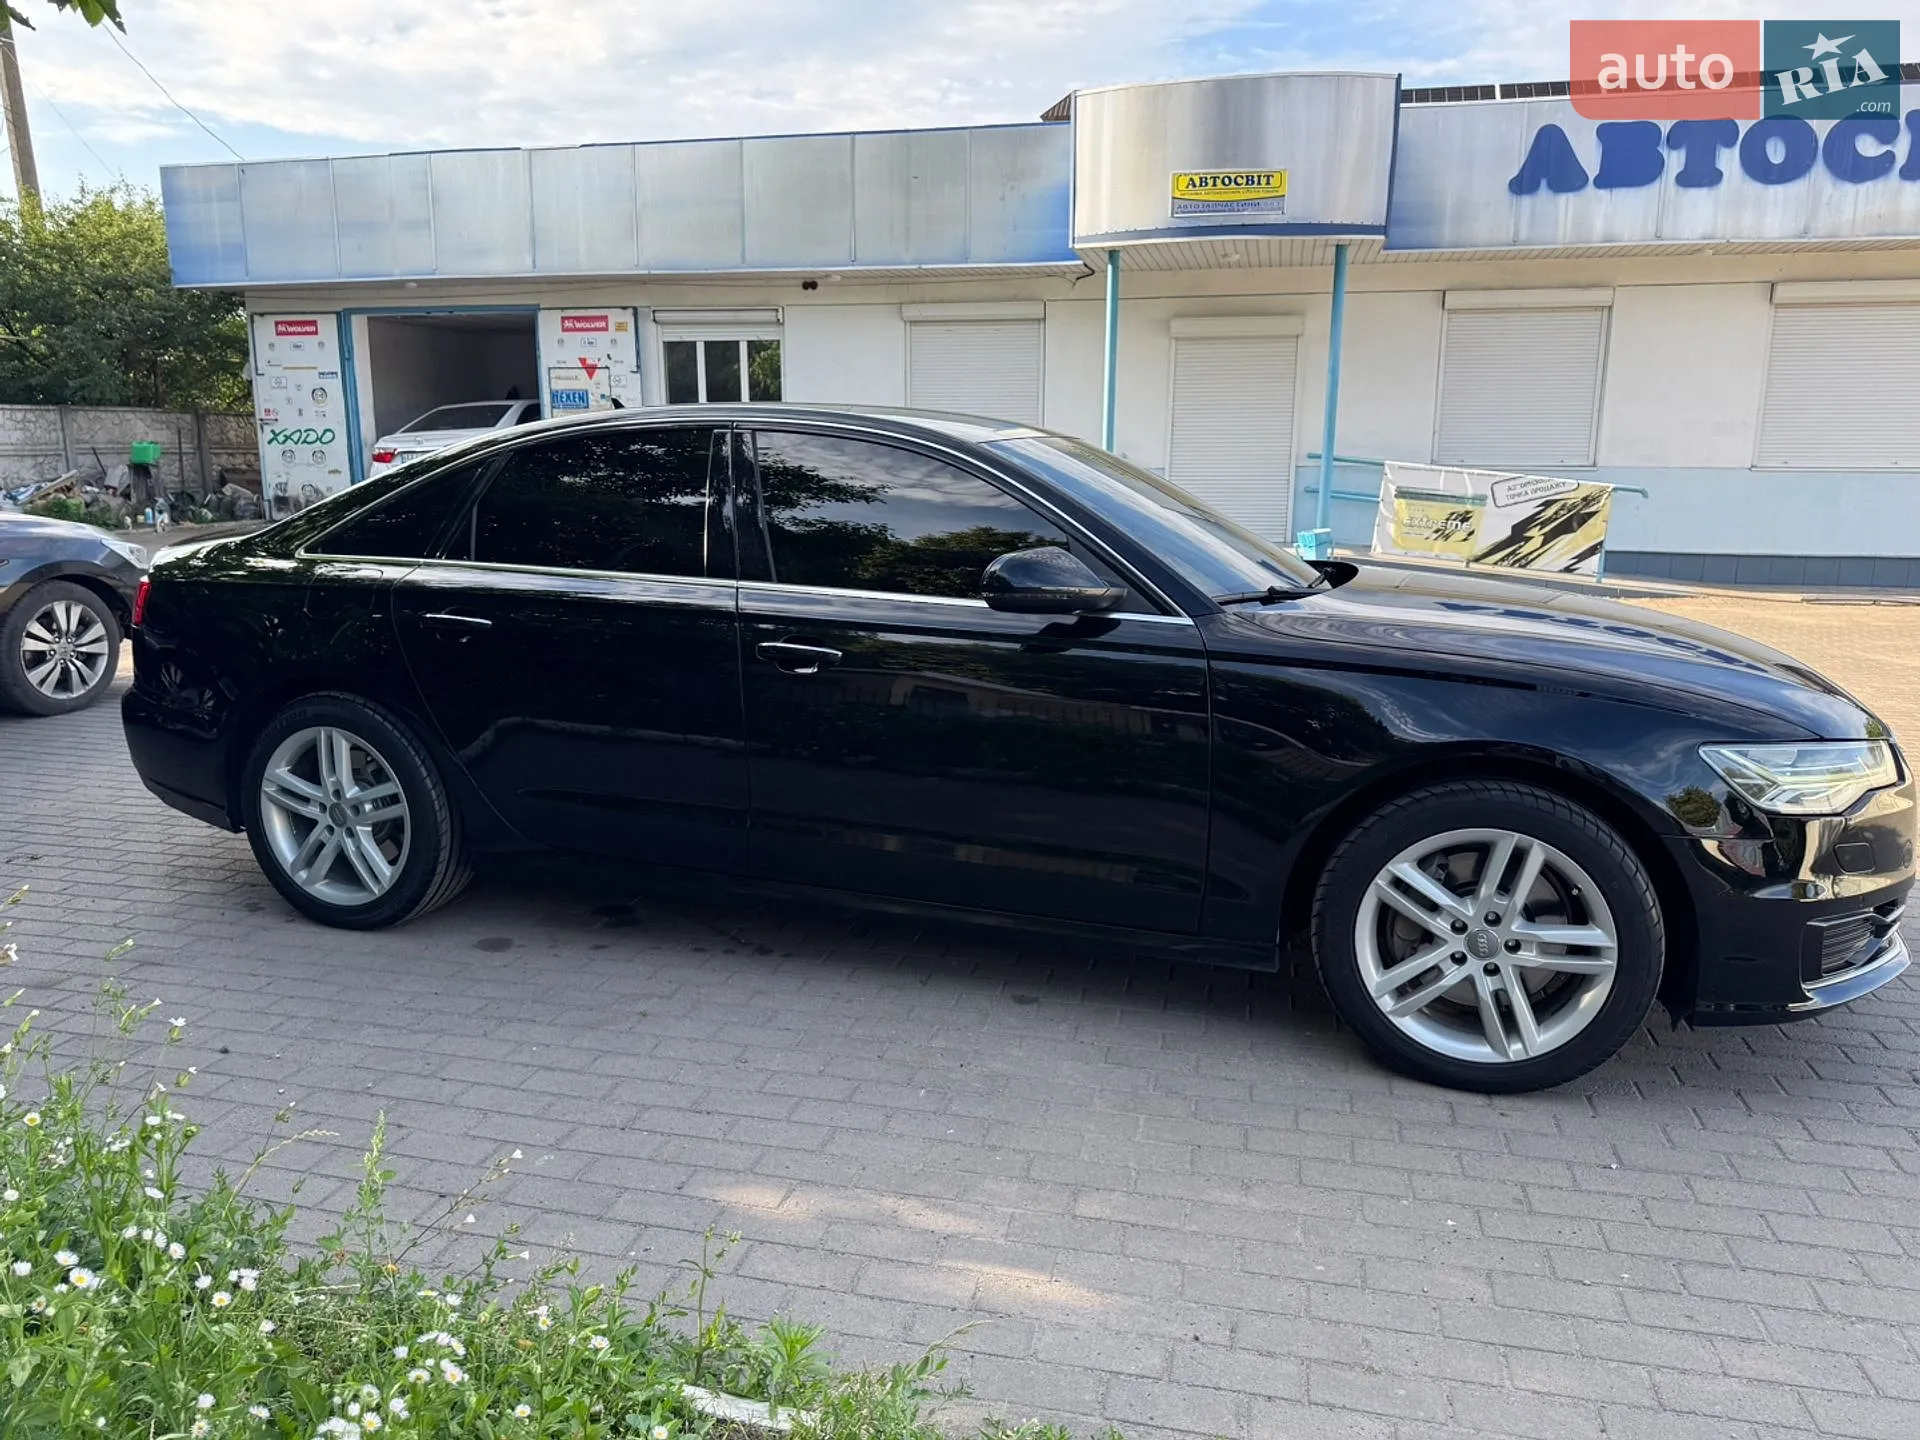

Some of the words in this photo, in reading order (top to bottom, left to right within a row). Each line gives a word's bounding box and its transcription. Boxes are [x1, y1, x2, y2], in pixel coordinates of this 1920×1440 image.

[1508, 108, 1920, 195] АВТОС
[1186, 174, 1274, 188] АВТОСВІТ
[267, 427, 336, 445] XADO
